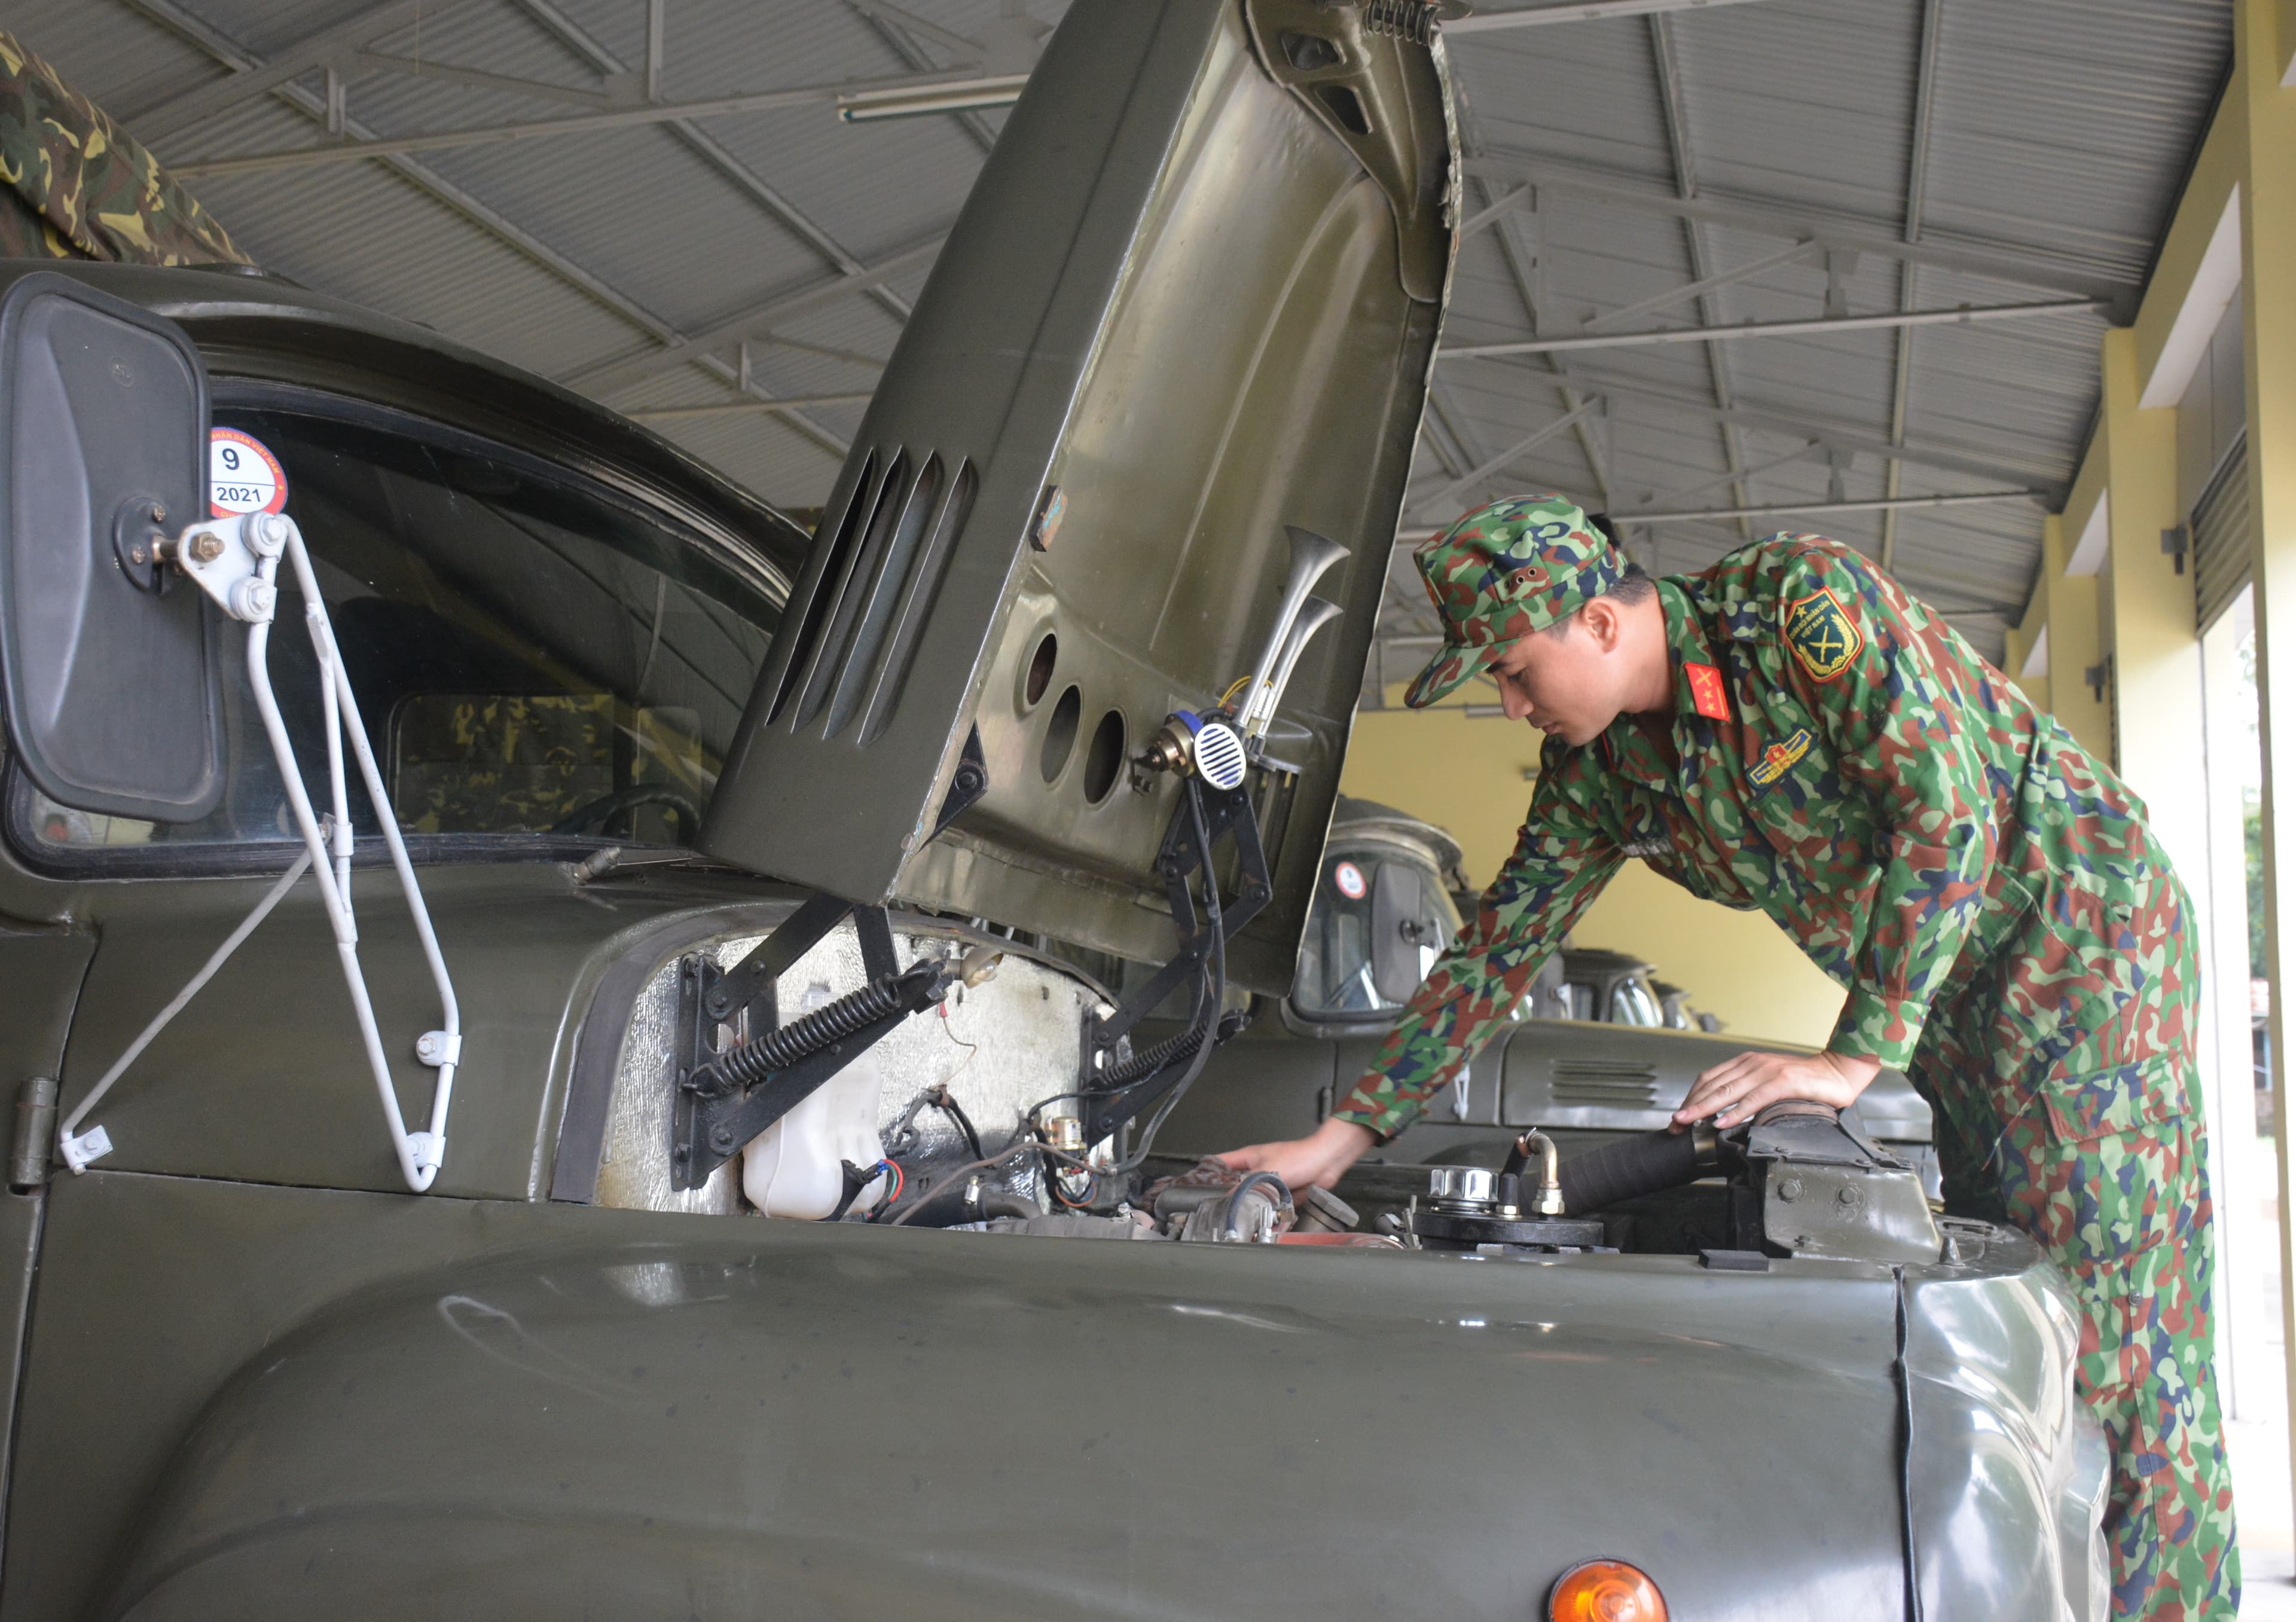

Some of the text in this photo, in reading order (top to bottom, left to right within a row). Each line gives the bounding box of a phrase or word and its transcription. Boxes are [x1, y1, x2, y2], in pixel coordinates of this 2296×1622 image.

[222, 448, 240, 471] 9
[267, 458, 279, 473] NAM
[216, 487, 261, 502] 2021
[1812, 615, 1825, 628] NAM
